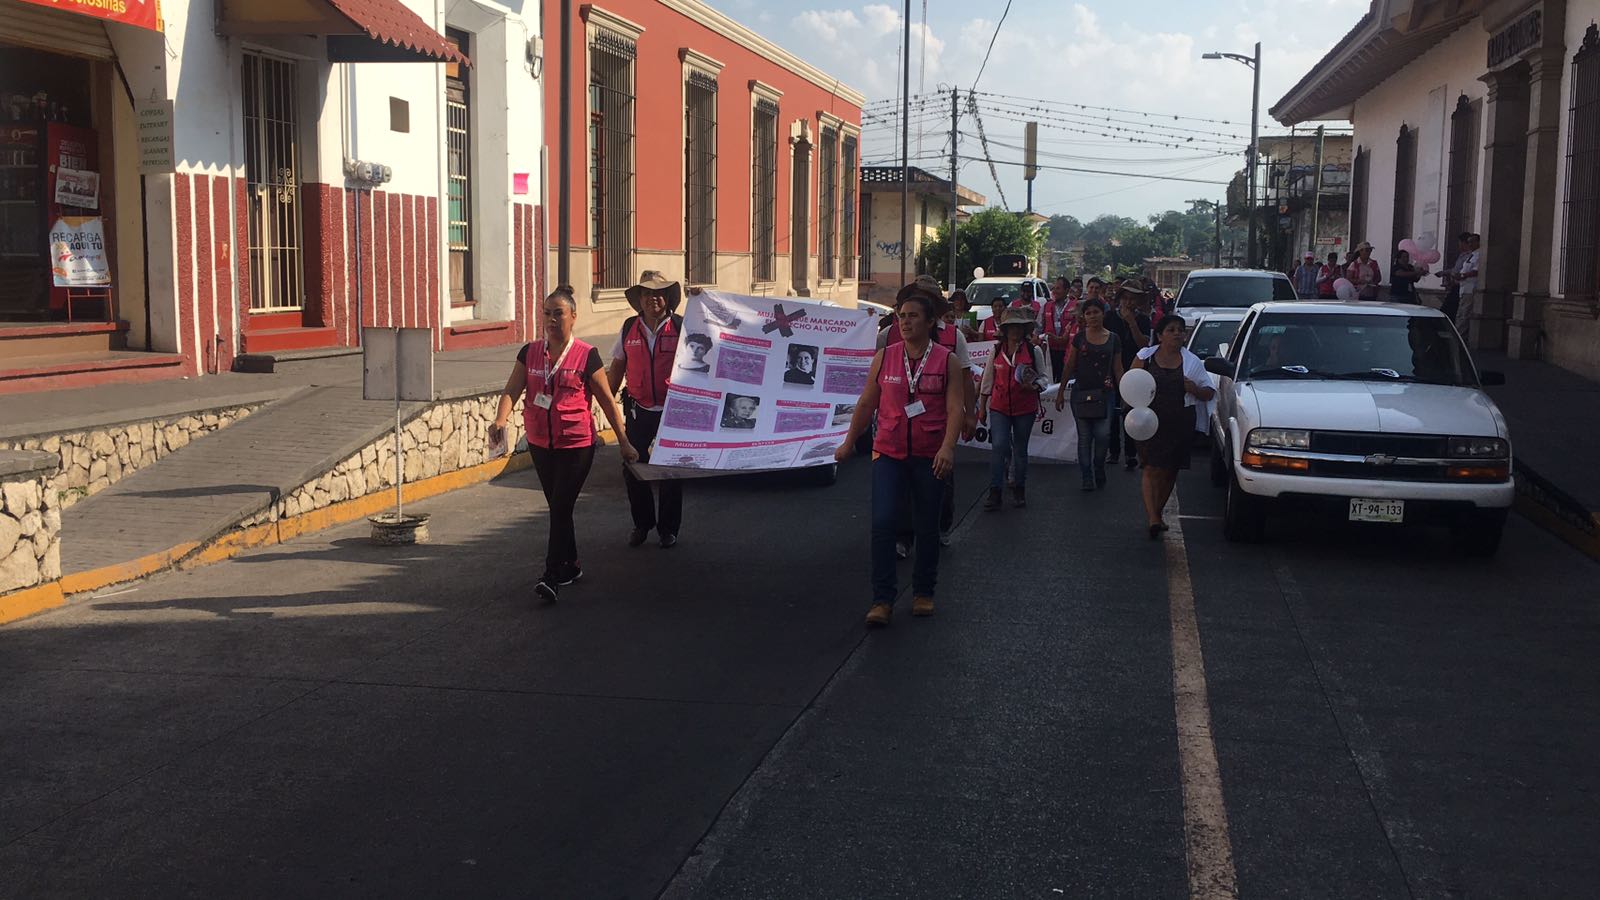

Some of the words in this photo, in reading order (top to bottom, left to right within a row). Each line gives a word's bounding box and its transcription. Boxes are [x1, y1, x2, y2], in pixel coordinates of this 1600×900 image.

[139, 121, 168, 129] INTERNET
[52, 232, 101, 243] RECARGA
[70, 242, 90, 250] AQUI
[91, 242, 103, 250] TU
[809, 317, 857, 327] MARCARON
[1351, 503, 1402, 515] XT-94-133
